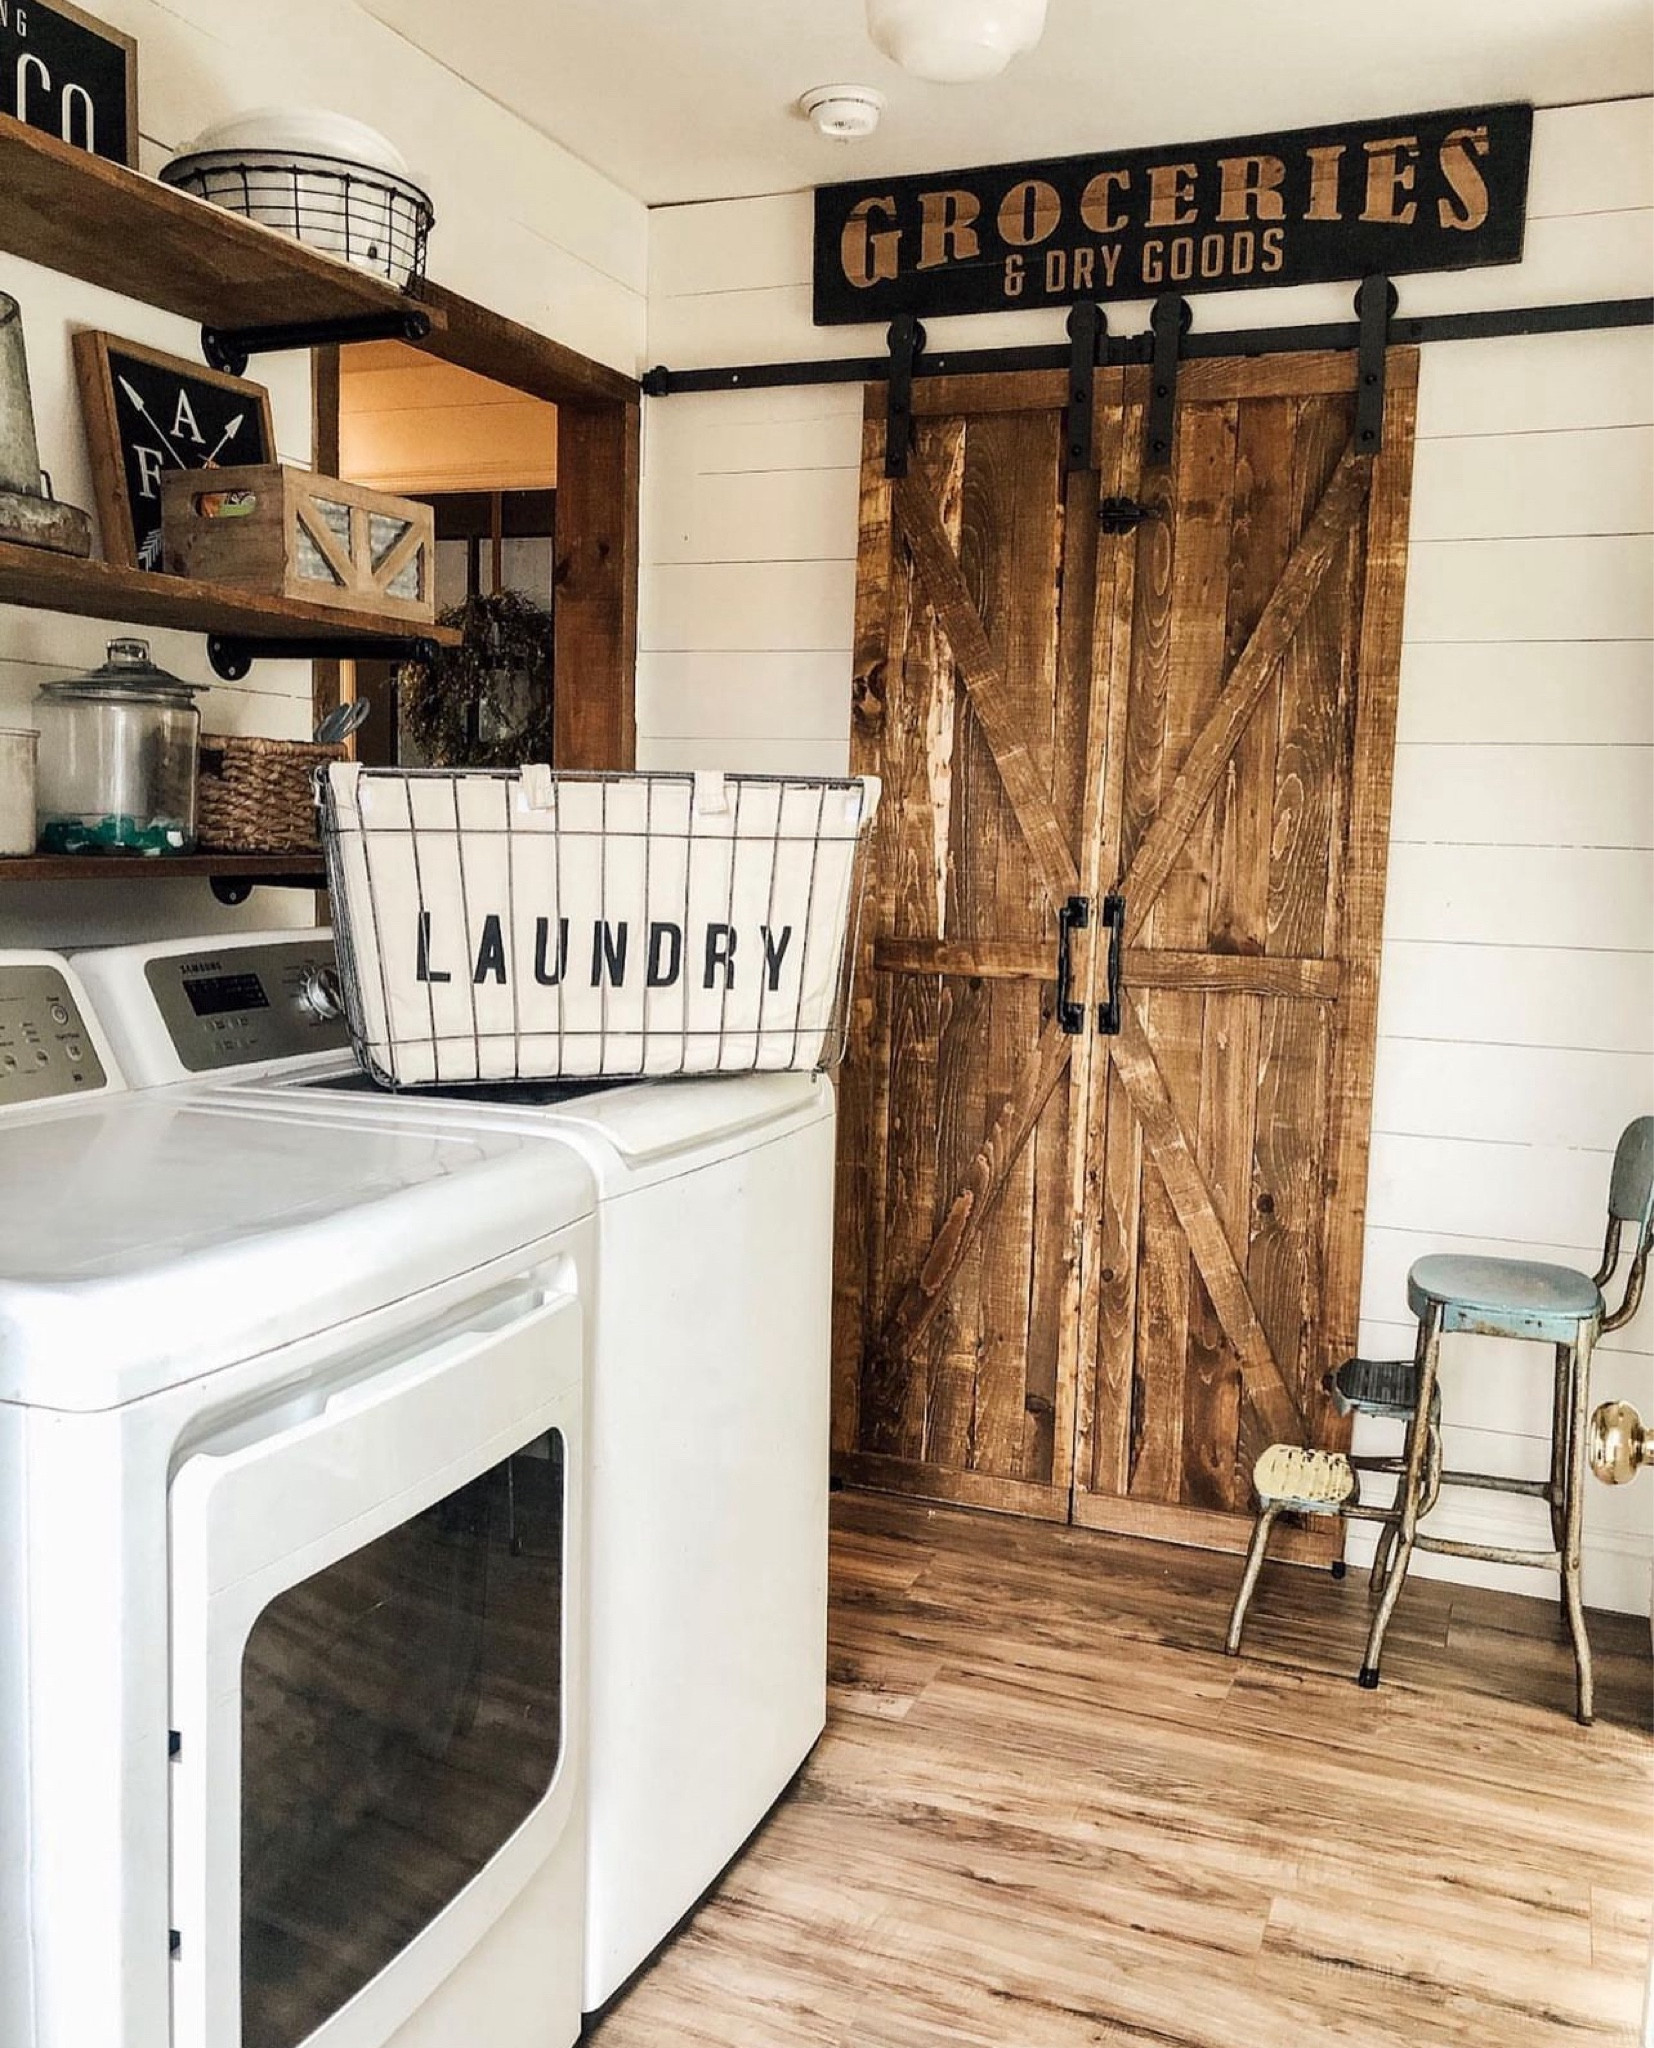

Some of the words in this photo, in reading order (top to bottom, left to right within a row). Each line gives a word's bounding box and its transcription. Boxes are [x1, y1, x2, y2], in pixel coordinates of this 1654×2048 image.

[840, 126, 1490, 288] GROCERIES
[1003, 253, 1026, 296] &
[1045, 244, 1122, 293] DRY
[1142, 227, 1286, 283] GOODS
[170, 388, 206, 444] A
[132, 444, 164, 499] F
[416, 911, 793, 991] LAUNDRY
